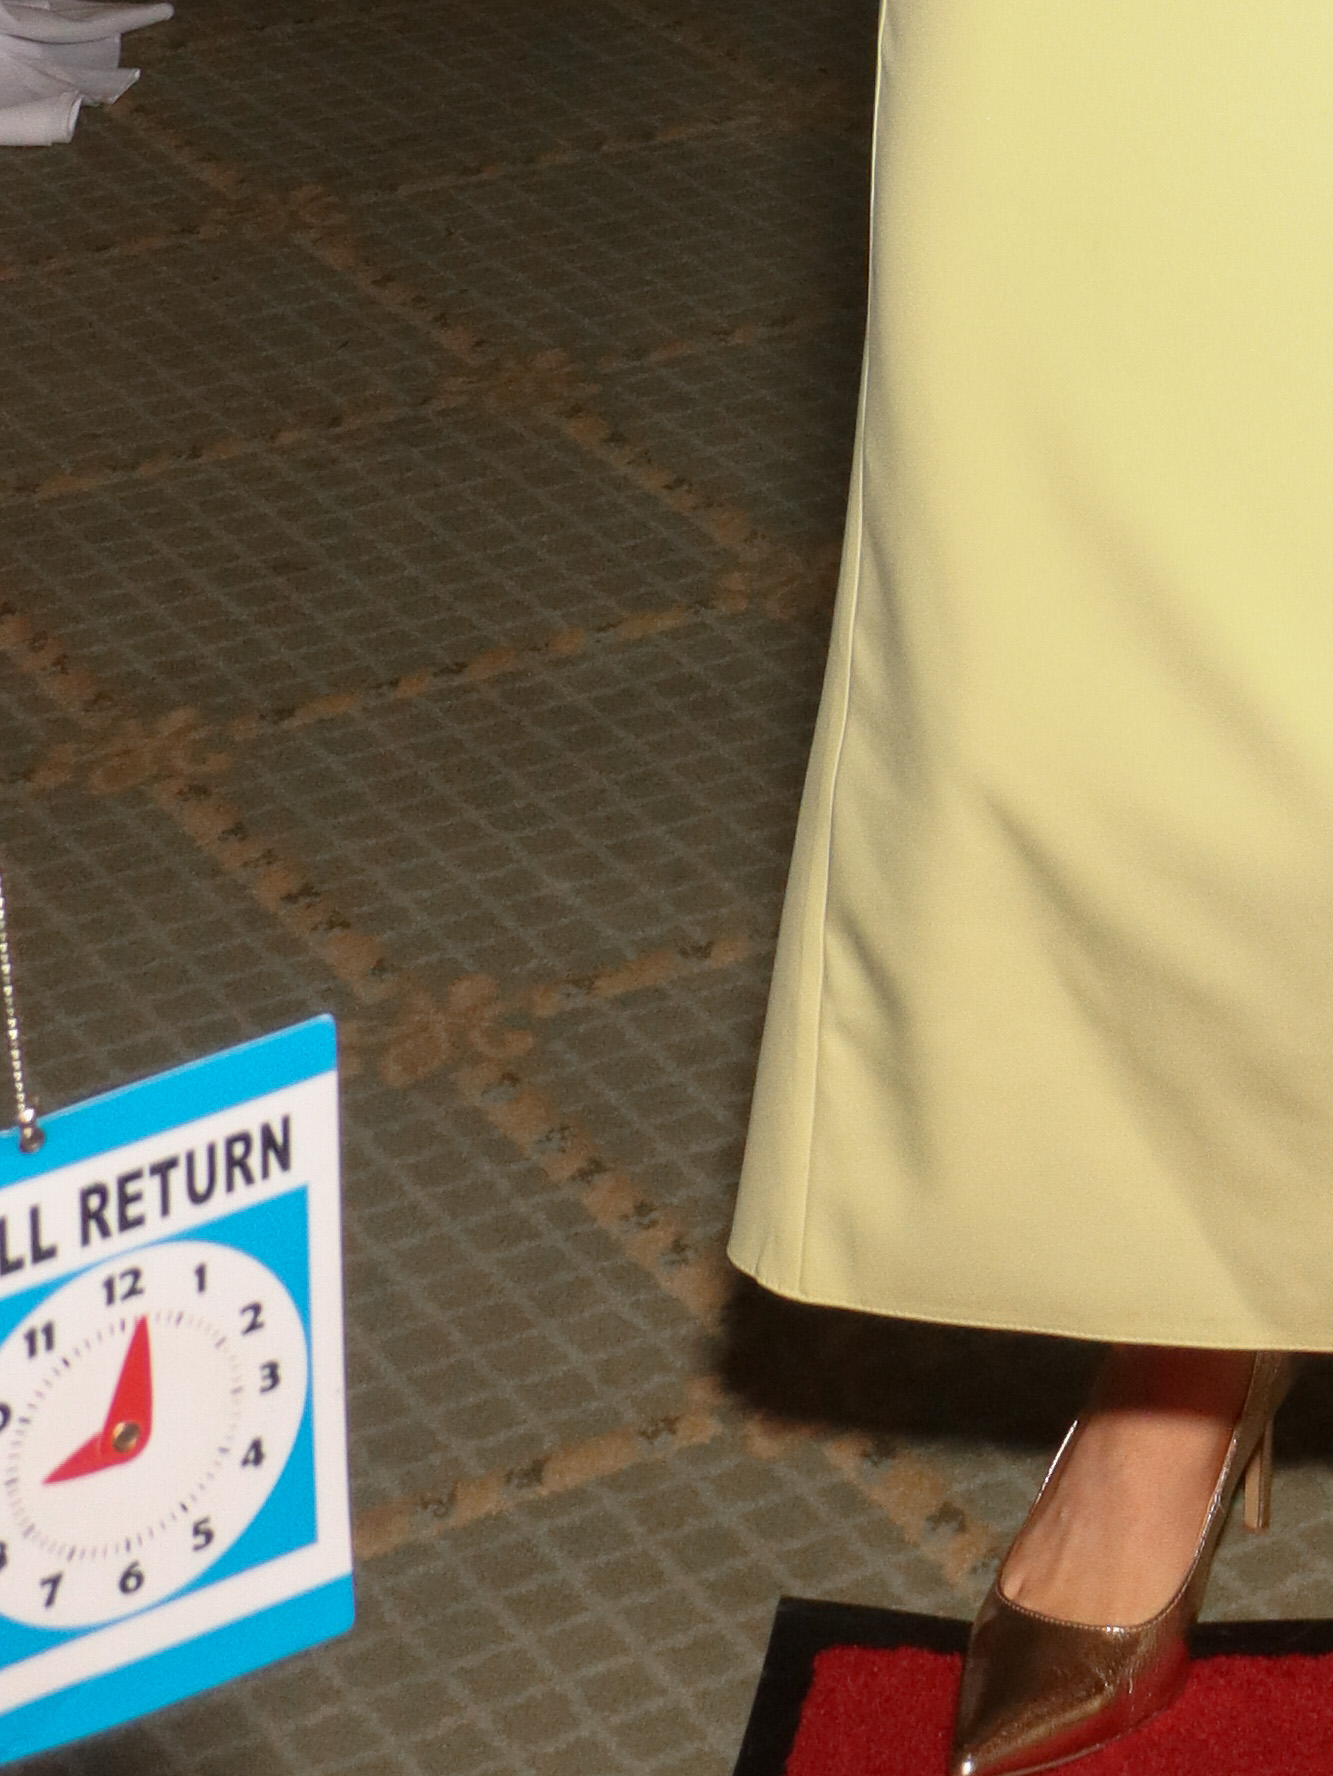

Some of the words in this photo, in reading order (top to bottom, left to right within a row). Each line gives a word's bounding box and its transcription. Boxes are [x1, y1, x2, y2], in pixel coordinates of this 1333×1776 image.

[80, 1115, 291, 1247] RETURN
[102, 1268, 143, 1305] 12
[194, 1264, 206, 1292] 1
[241, 1302, 264, 1334] 2
[24, 1321, 56, 1358] 11
[259, 1362, 280, 1392] 3
[241, 1437, 265, 1468] 4
[192, 1517, 214, 1551] 5
[40, 1571, 63, 1608] 7
[118, 1560, 144, 1595] 6
